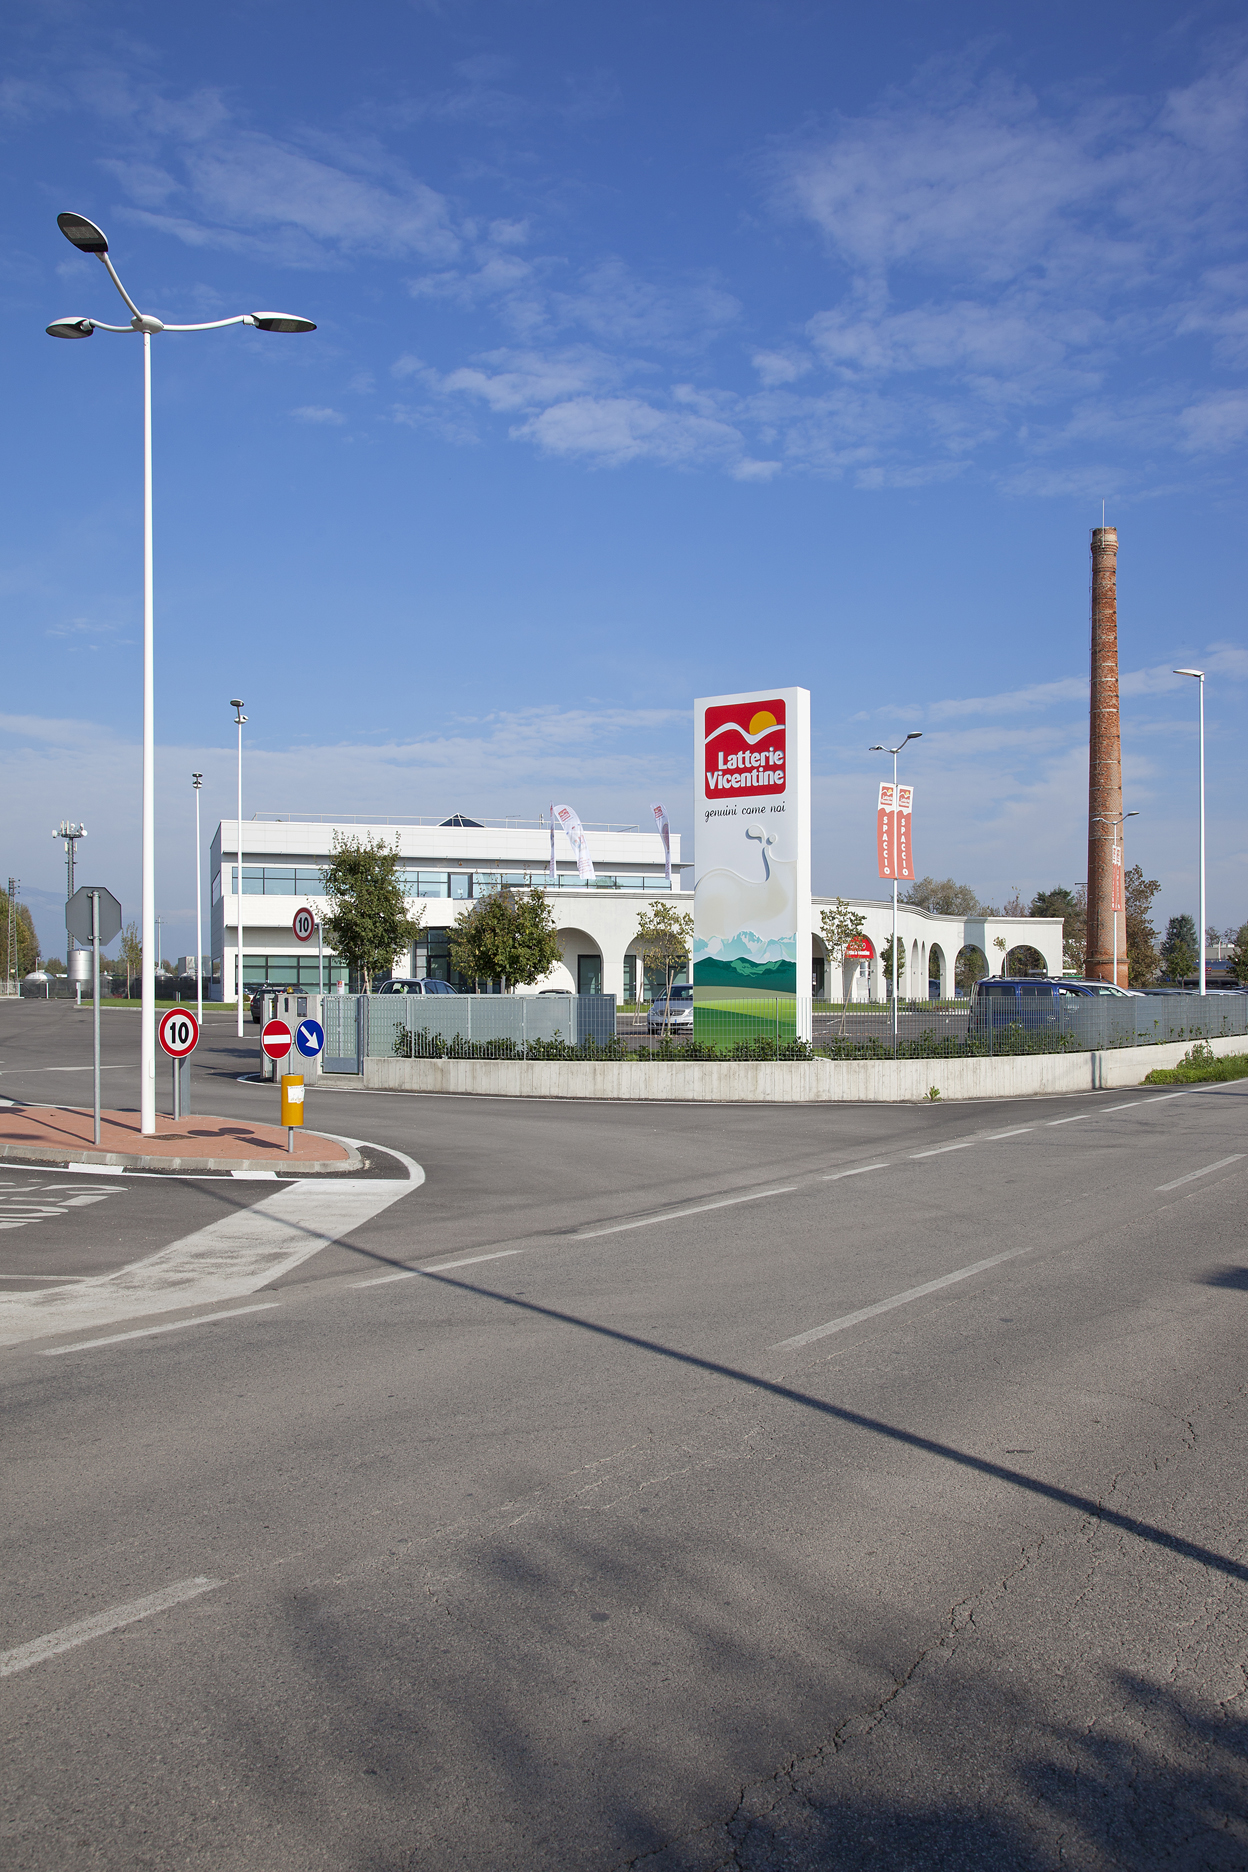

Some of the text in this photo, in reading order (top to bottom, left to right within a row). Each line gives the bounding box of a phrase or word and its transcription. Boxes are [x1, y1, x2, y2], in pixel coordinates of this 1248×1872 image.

[718, 746, 785, 770] Latterie
[706, 767, 785, 790] Vicentine
[704, 801, 786, 823] genuini come noi
[882, 816, 891, 875] SPACCIO
[900, 818, 909, 876] SPACCIO
[298, 916, 309, 933] 10
[169, 1021, 189, 1044] 10
